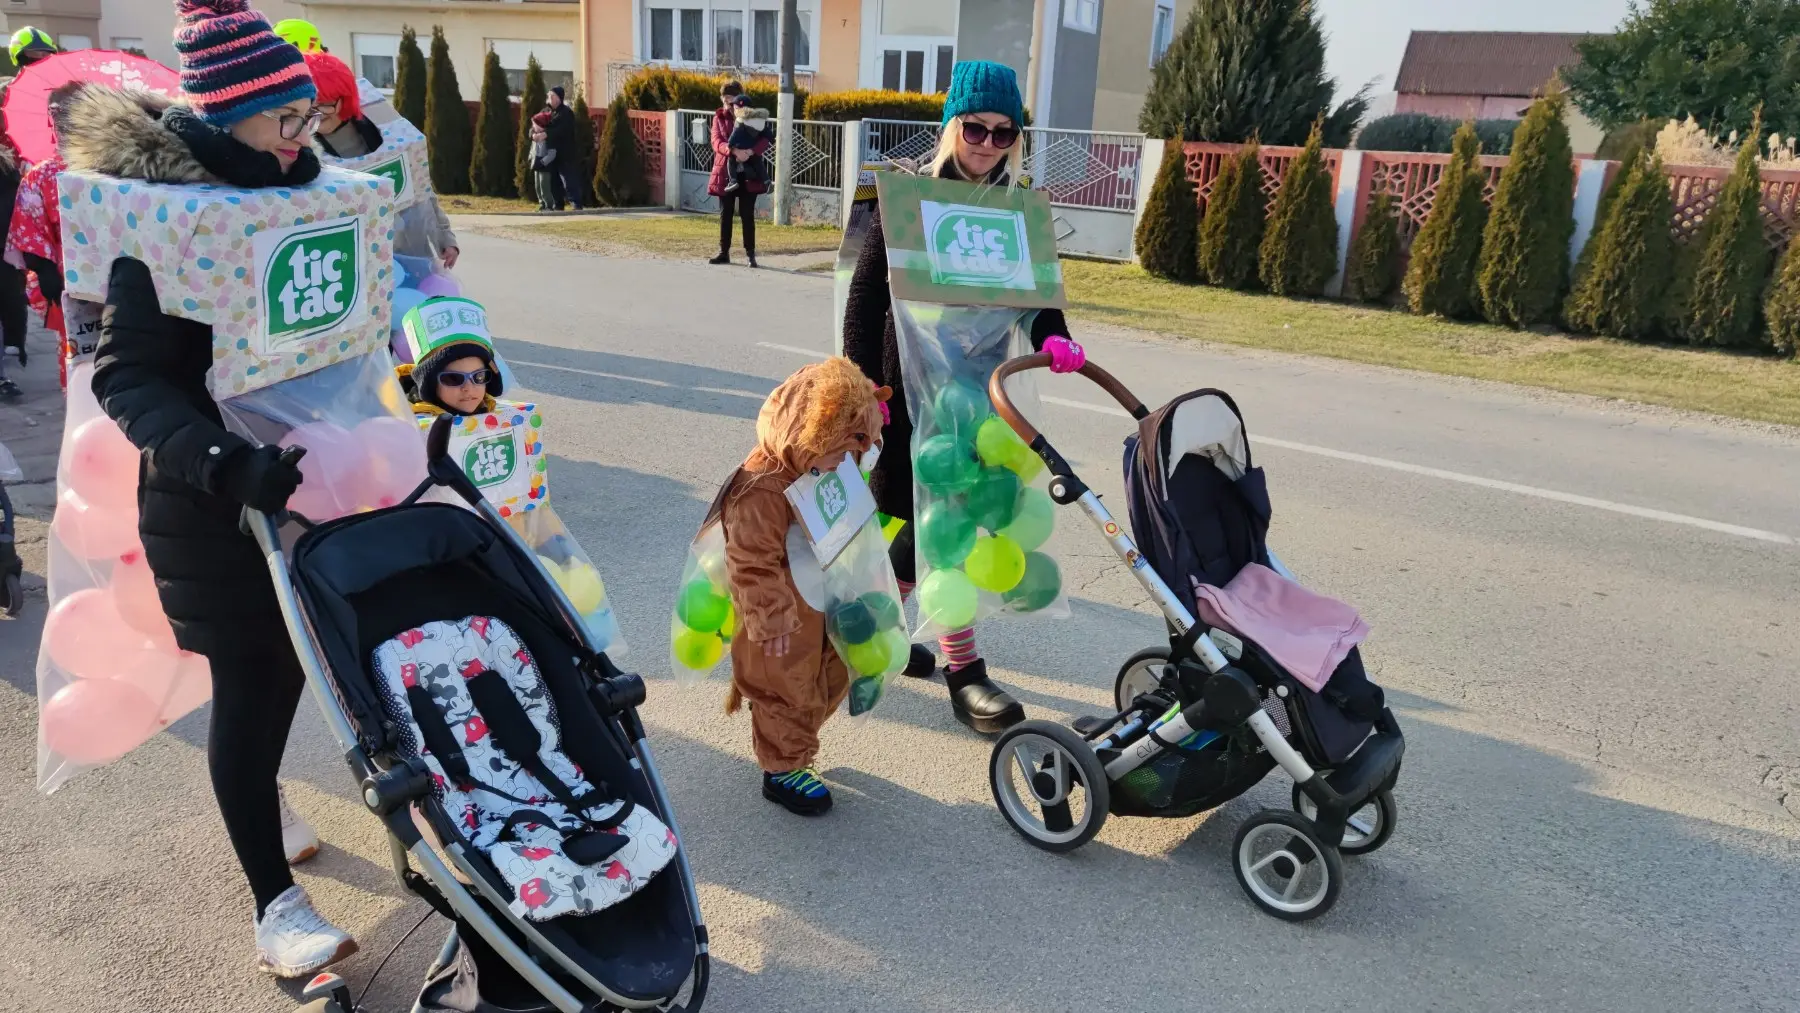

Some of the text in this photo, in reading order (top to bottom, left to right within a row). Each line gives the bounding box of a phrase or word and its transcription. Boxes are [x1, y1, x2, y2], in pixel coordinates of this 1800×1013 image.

[842, 18, 848, 28] 7
[953, 218, 1005, 252] tic
[288, 244, 342, 289] tic
[946, 240, 1009, 273] tac
[278, 280, 344, 325] tac
[475, 443, 507, 464] tic
[471, 460, 509, 481] tac
